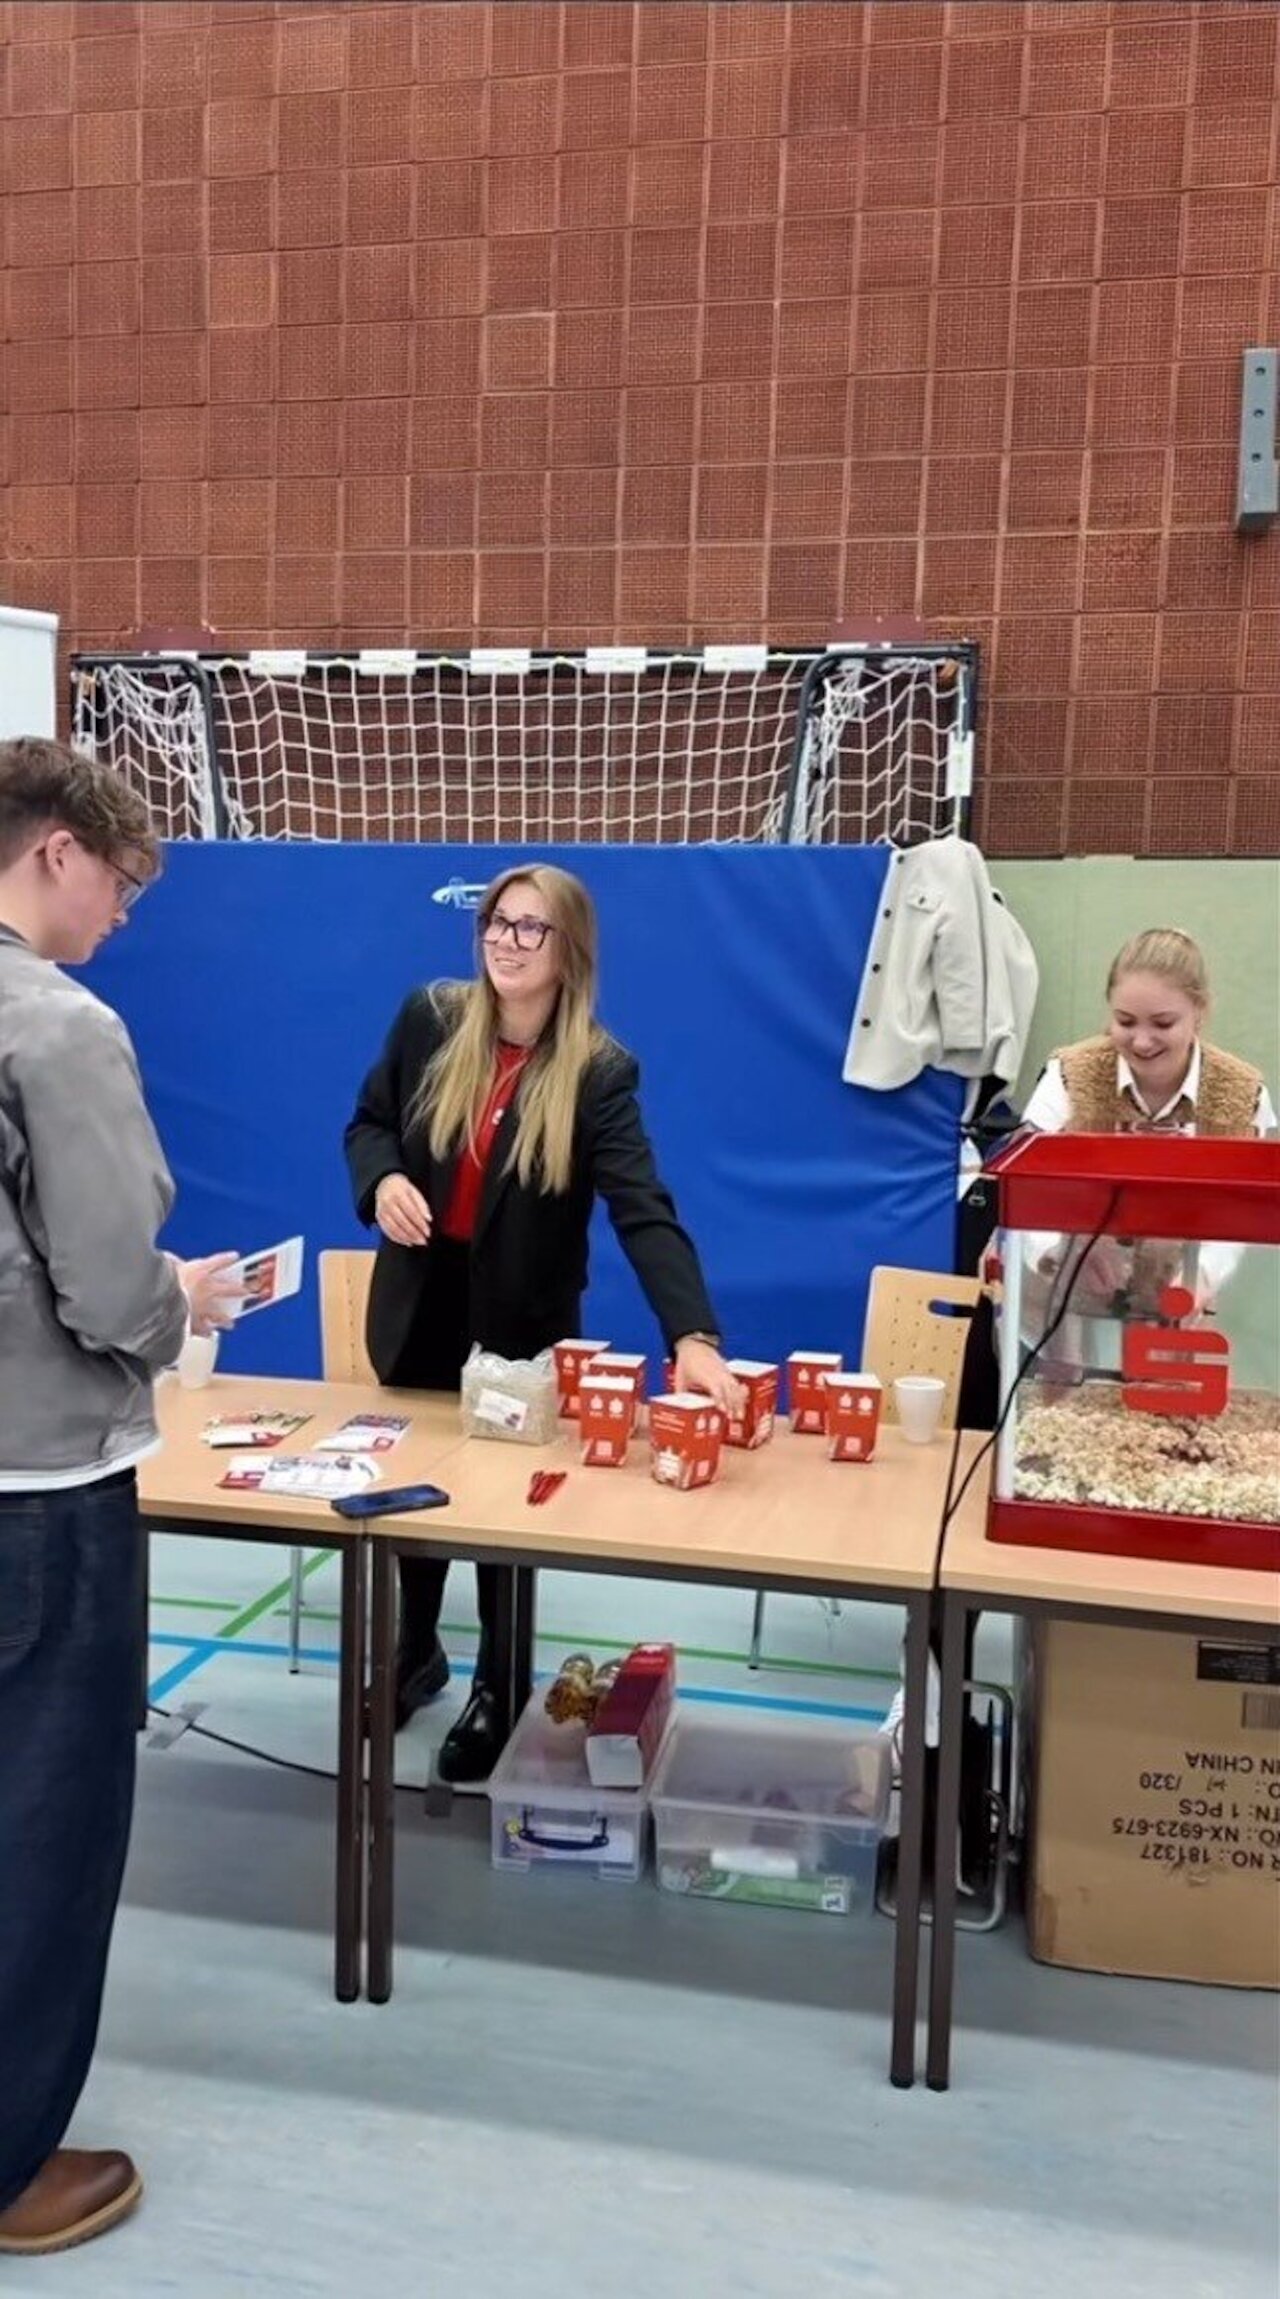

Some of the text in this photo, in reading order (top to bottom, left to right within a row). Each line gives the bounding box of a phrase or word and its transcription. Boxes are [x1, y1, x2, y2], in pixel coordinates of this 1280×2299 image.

[1185, 1752, 1253, 1773] CHINA
[1140, 1771, 1182, 1791] /320
[1179, 1798, 1223, 1818] PCS
[1232, 1803, 1240, 1818] 1
[1112, 1817, 1280, 1848] O.: NX-6923-675
[1140, 1843, 1211, 1864] 181327
[1220, 1850, 1264, 1869] NO.:
